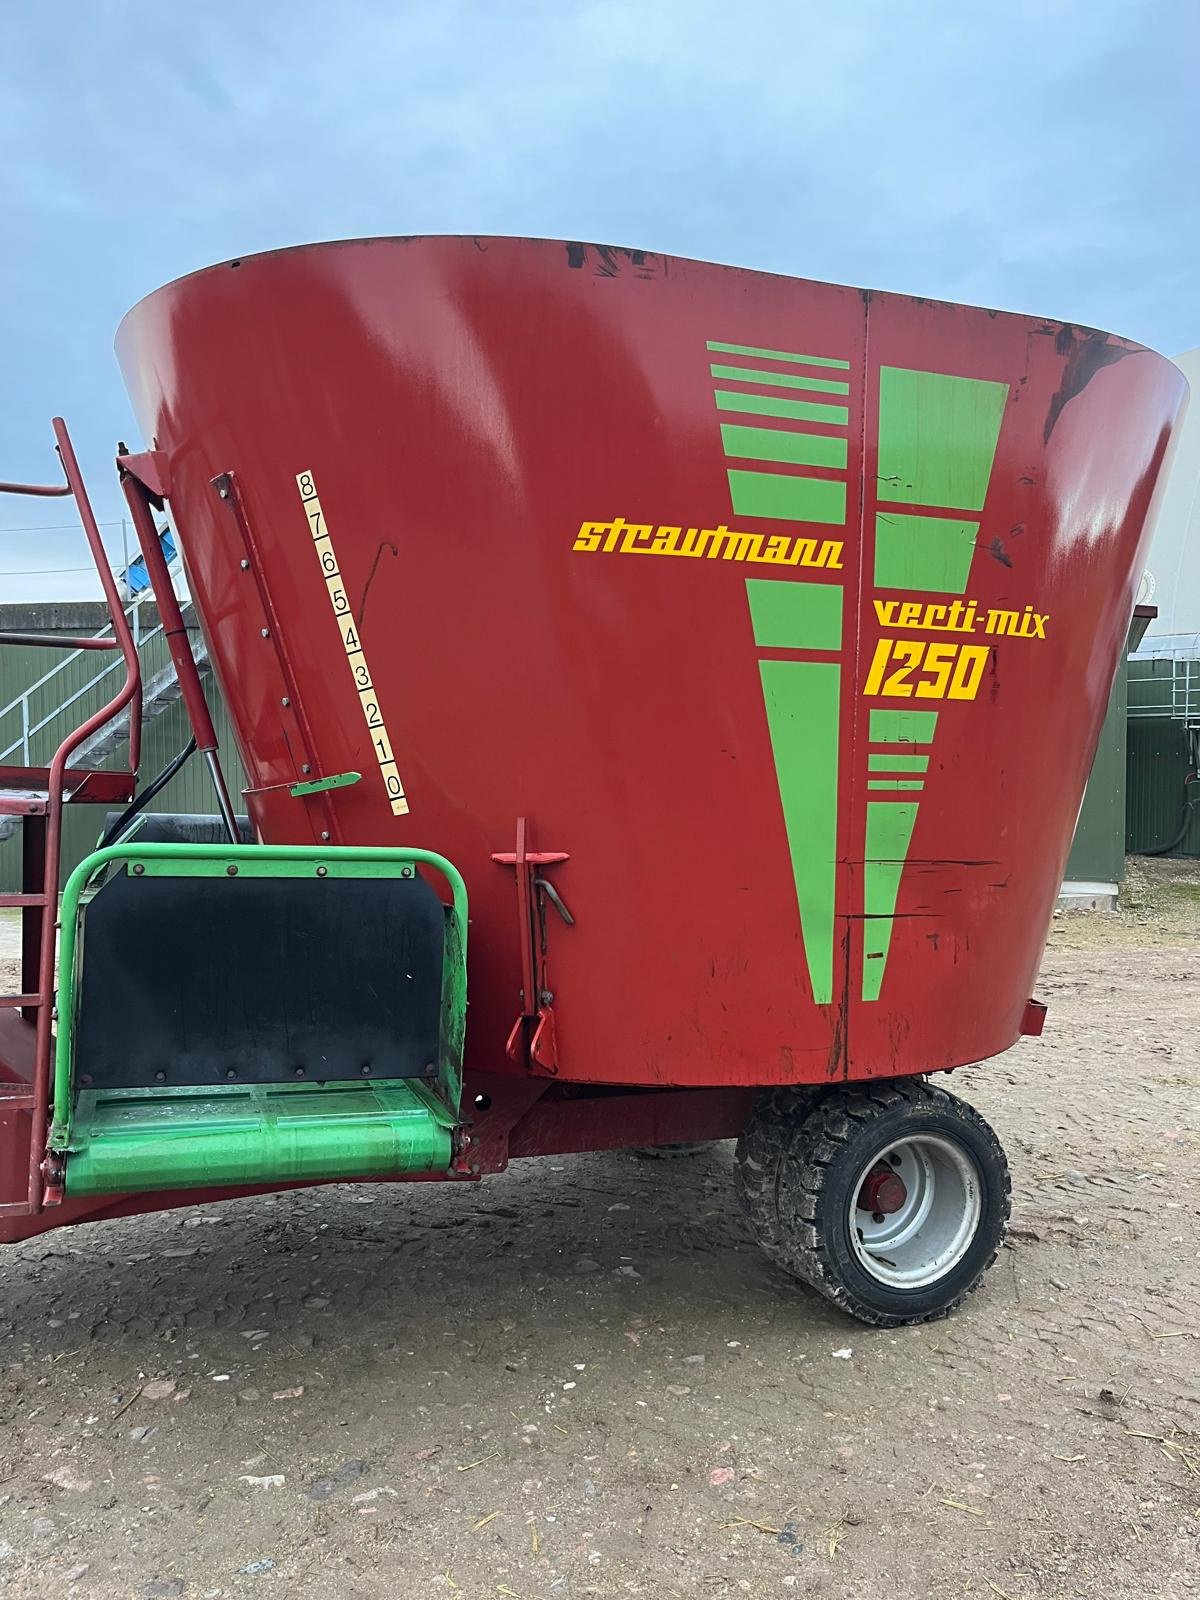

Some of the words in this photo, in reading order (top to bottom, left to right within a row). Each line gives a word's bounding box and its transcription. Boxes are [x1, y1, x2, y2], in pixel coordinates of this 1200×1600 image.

[299, 474, 314, 496] 8
[309, 511, 321, 535] 7
[572, 517, 844, 569] strautmann
[322, 551, 336, 572] 6
[333, 589, 347, 611] 5
[872, 599, 1050, 639] verti-mix
[344, 628, 358, 648] 4
[355, 665, 369, 686] 3
[863, 638, 990, 701] 1250
[366, 703, 381, 724] 2
[376, 738, 387, 759] 1
[387, 775, 401, 795] 0
